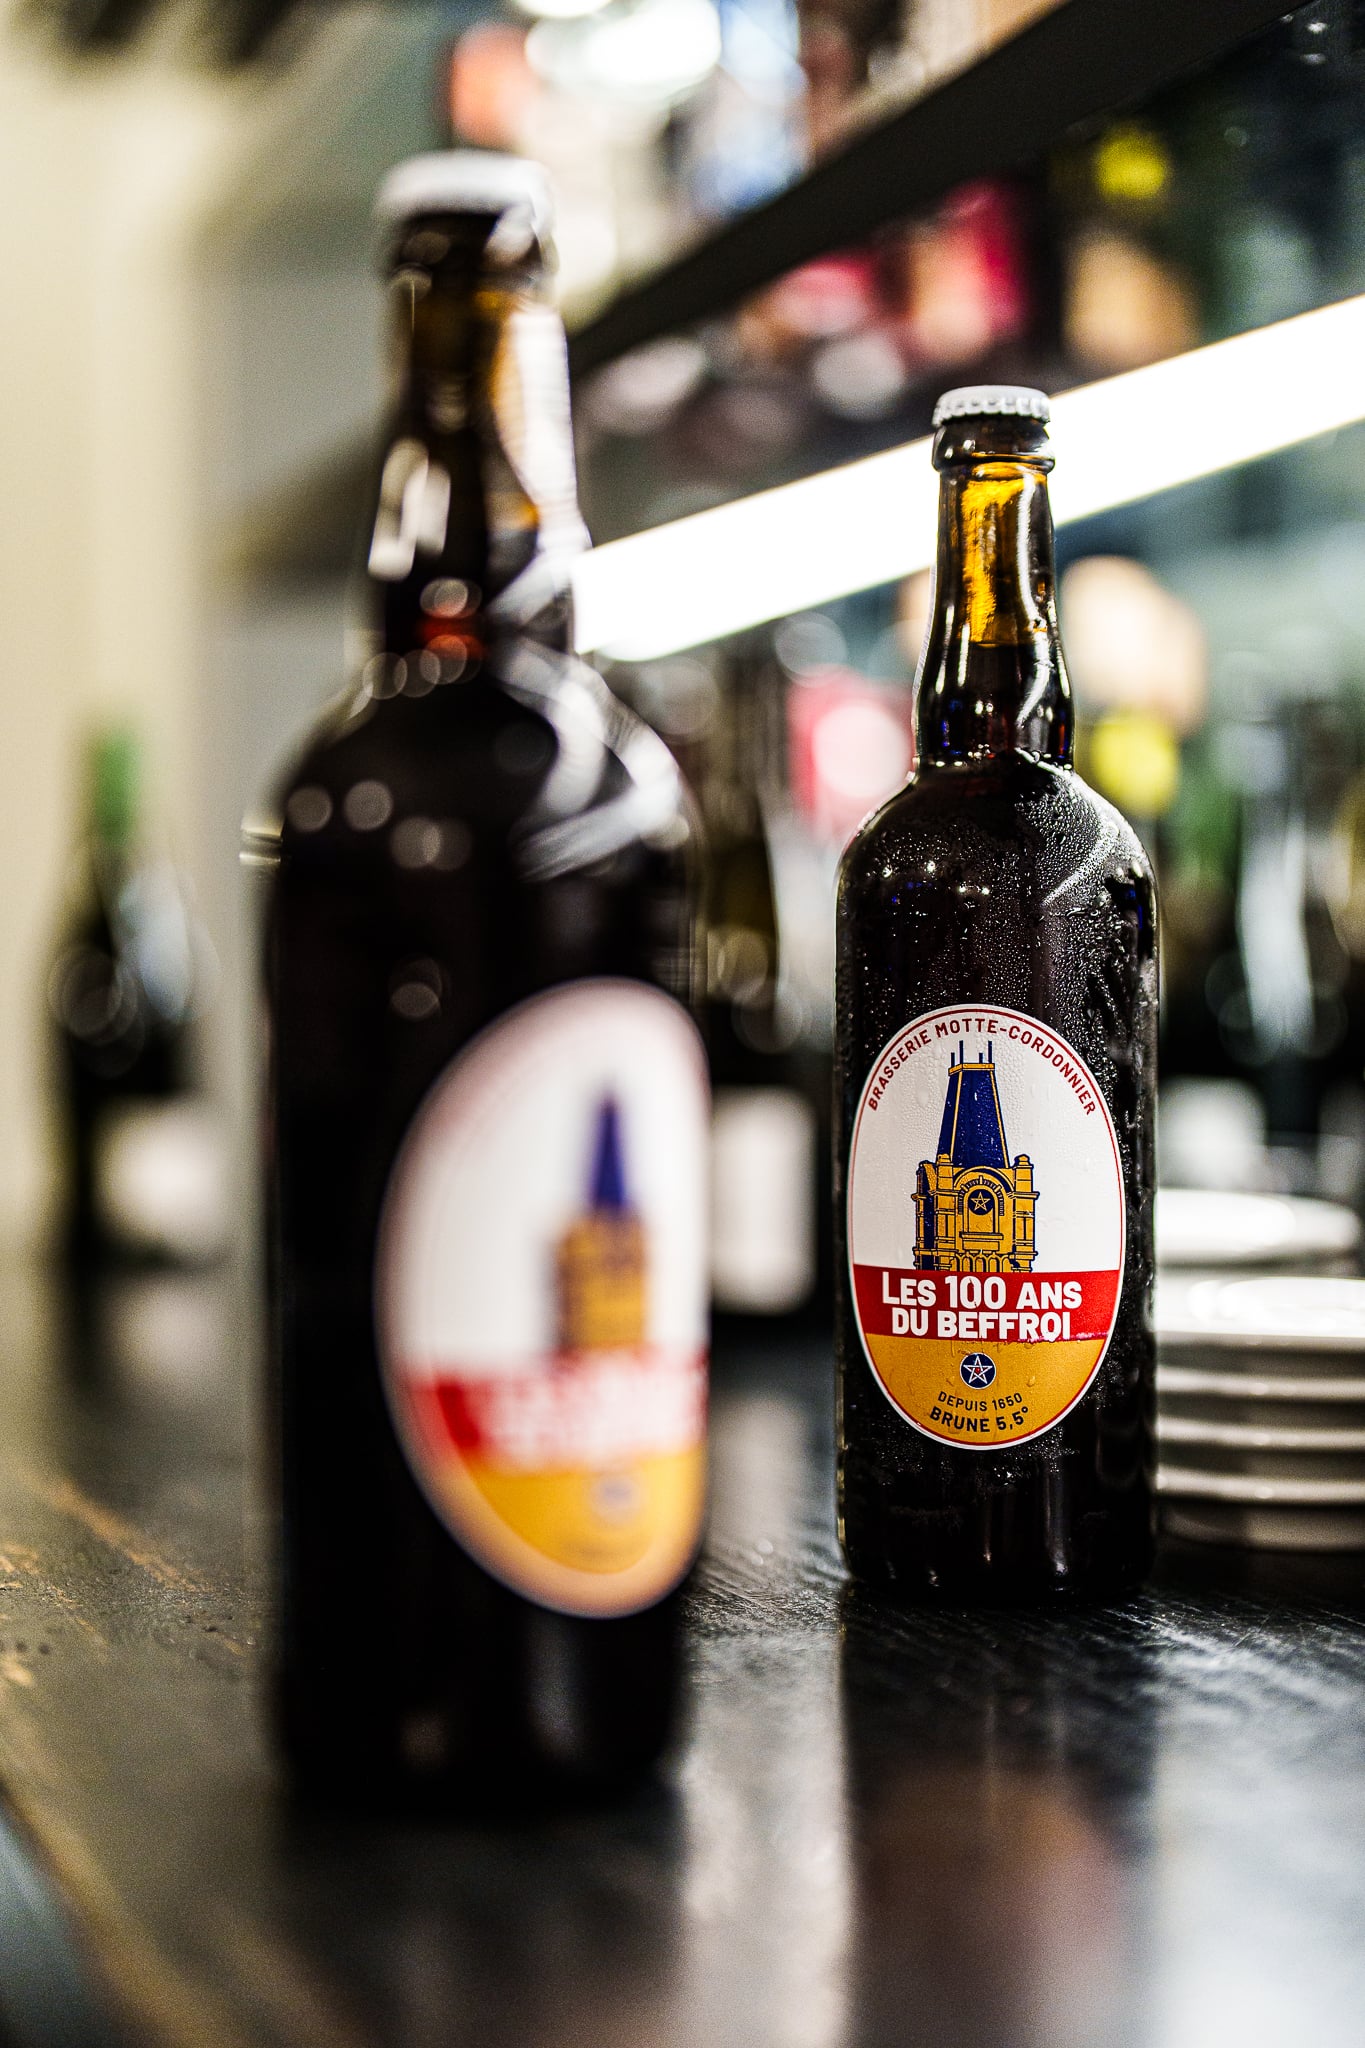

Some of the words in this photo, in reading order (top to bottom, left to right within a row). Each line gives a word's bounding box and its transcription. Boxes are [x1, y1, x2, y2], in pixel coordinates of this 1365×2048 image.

[868, 1029, 932, 1111] BRASSERIE
[934, 1018, 1096, 1116] MOTTE-CORDONNIER
[882, 1271, 937, 1307] LES
[944, 1275, 1007, 1309] 100
[1016, 1281, 1082, 1310] ANS
[891, 1307, 929, 1336] DU
[937, 1310, 1071, 1342] BEFFROI
[937, 1391, 988, 1412] DEPUIS
[991, 1392, 1023, 1411] 1650
[929, 1406, 991, 1433] BRUNE
